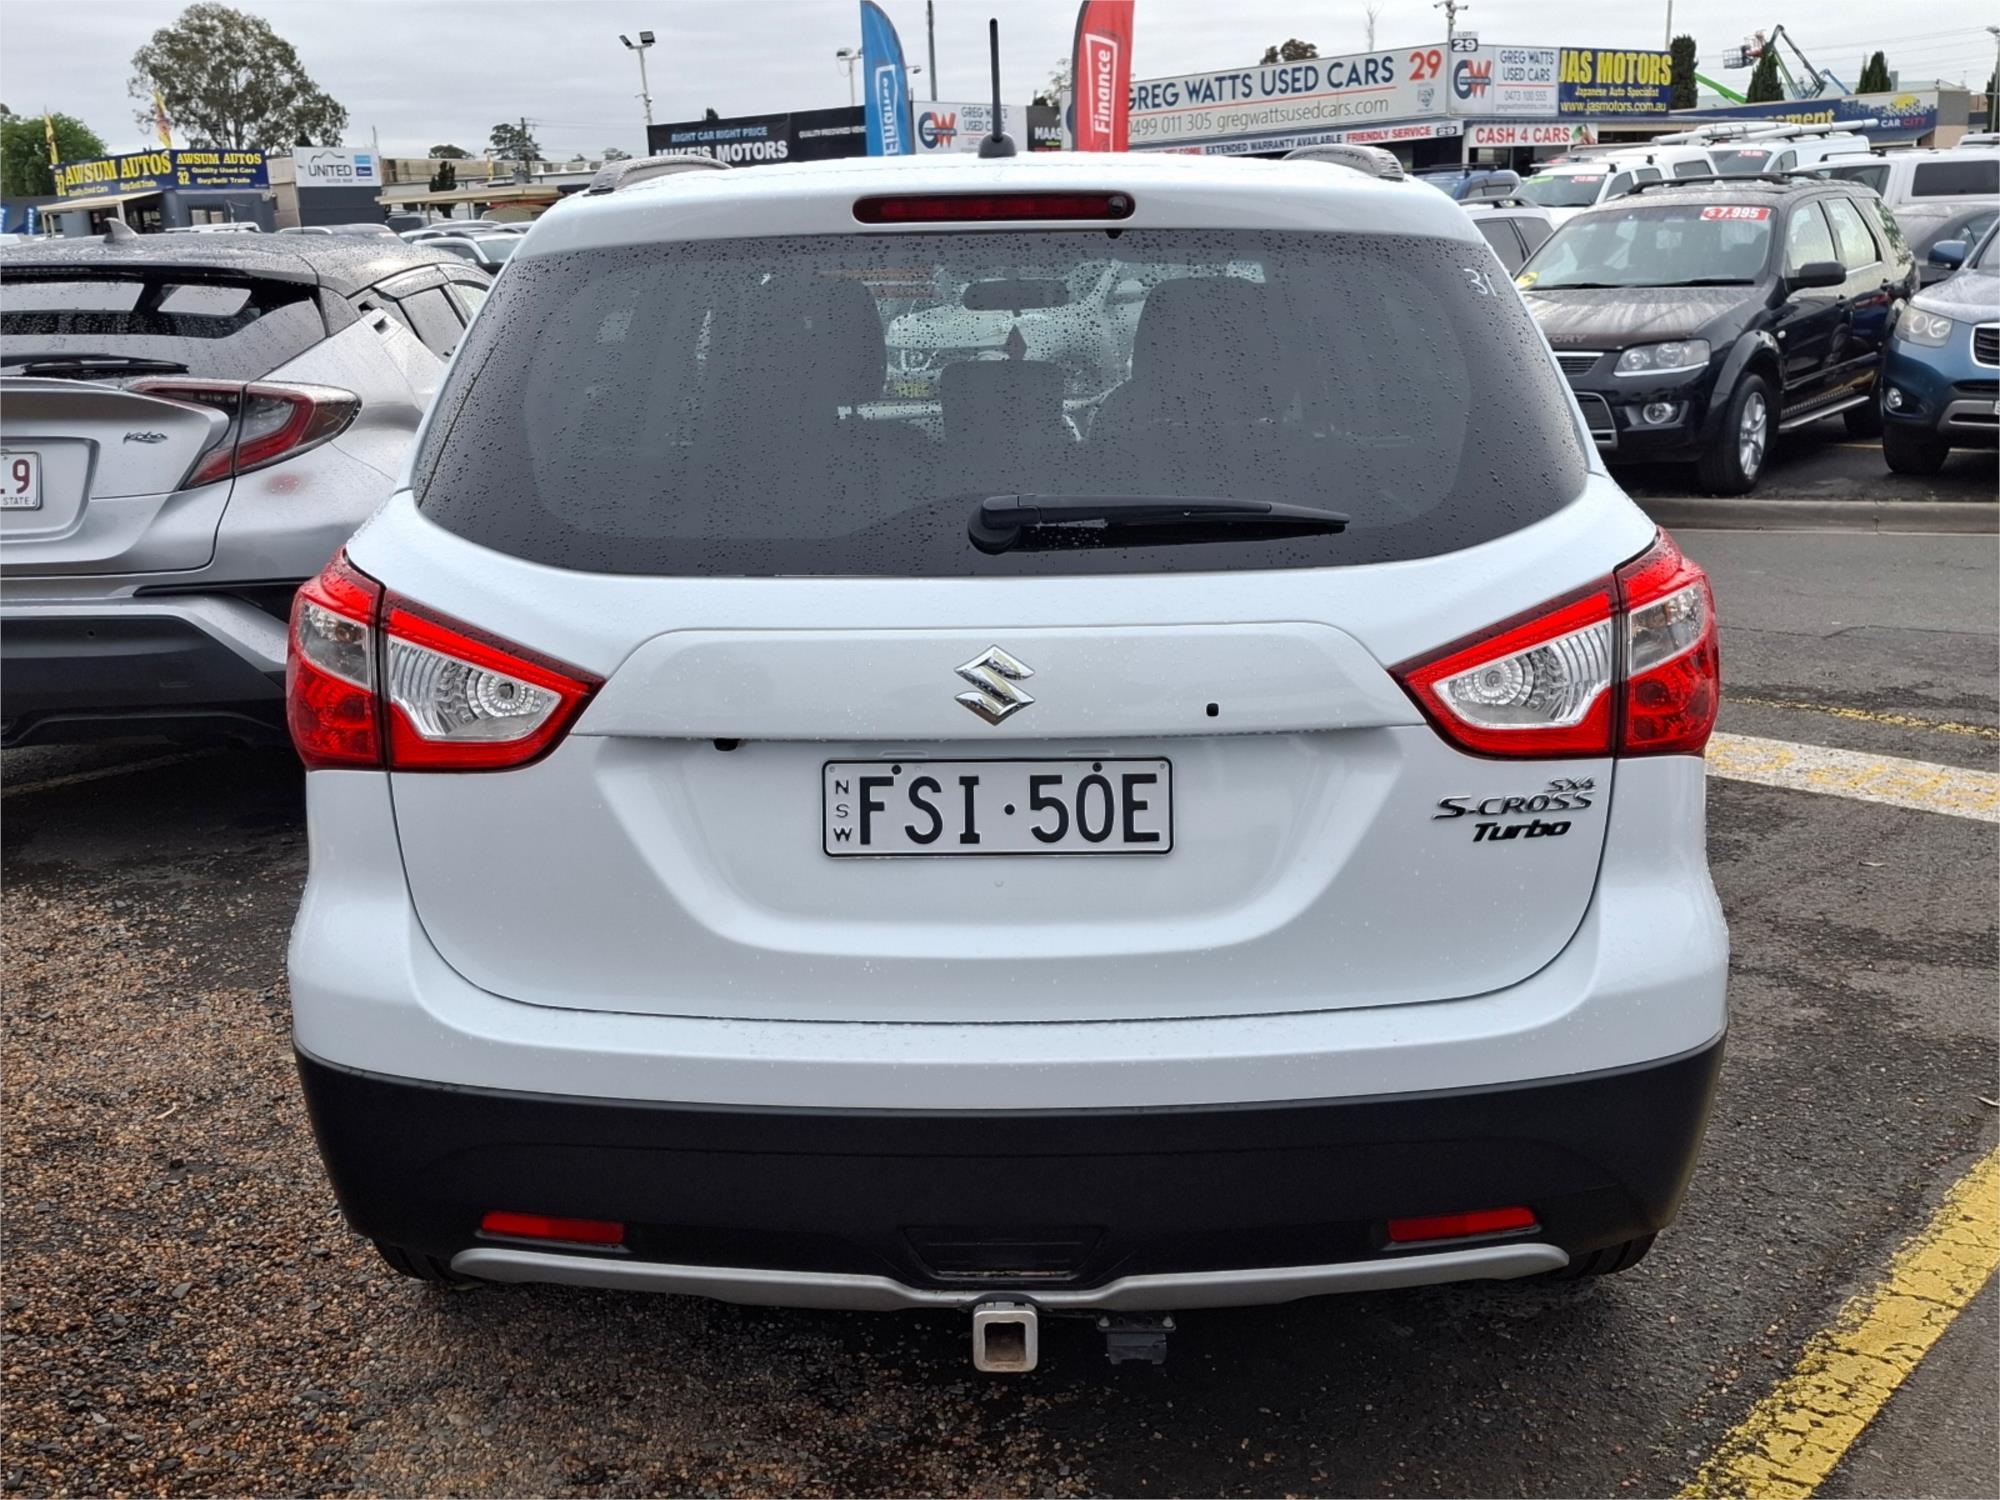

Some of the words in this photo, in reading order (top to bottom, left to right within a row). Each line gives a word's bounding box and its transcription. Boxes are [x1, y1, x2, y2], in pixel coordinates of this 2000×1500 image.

[1453, 39, 1476, 51] 29
[1409, 49, 1442, 81] 29
[1500, 50, 1526, 64] GREG
[1528, 51, 1554, 65] WATTS
[1503, 67, 1525, 81] USED
[1527, 68, 1551, 82] CARS
[1559, 50, 1592, 84] JAS
[1597, 51, 1672, 86] MOTORS
[1094, 49, 1111, 134] Finance
[1128, 82, 1179, 111] GREG
[1184, 74, 1252, 104] WATTS
[1261, 65, 1319, 96] USED
[1327, 56, 1394, 88] CARS
[1575, 86, 1607, 98] Japanese
[1609, 86, 1625, 96] Auto
[1627, 87, 1659, 98] Specialist
[961, 106, 984, 118] GREG
[1560, 99, 1666, 115] www.jasmotors.com.au
[1161, 115, 1182, 134] 011
[1186, 112, 1212, 131] 305
[1217, 99, 1389, 133] gregwattsusedcars.com
[1881, 119, 1901, 128] CAR
[1903, 117, 1926, 126] CITY
[671, 132, 697, 143] RIGHT
[697, 130, 715, 141] CAR
[716, 128, 741, 140] RIGHT
[742, 126, 768, 138] PRICE
[964, 120, 983, 132] USED
[1205, 142, 1248, 155] EXTENDED
[1250, 138, 1296, 150] WARRANTY
[1297, 134, 1342, 146] AVAILABLE
[1346, 130, 1390, 142] FRIENDLY
[1391, 126, 1432, 139] SERVICE
[1475, 127, 1516, 144] CASH
[1519, 128, 1529, 142] 4
[1532, 127, 1570, 143] CARS
[176, 153, 220, 165] AWSUM
[223, 153, 262, 165] AUTOS
[716, 140, 788, 162] MOTORS
[65, 160, 118, 186] AWSUM
[120, 152, 172, 178] AUTOS
[308, 164, 352, 177] UNITED
[177, 171, 191, 185] 32
[1463, 267, 1497, 297] 31
[3, 496, 30, 505] STATE
[1431, 790, 1597, 820] S-CROSS
[1472, 818, 1573, 843] Turbo
